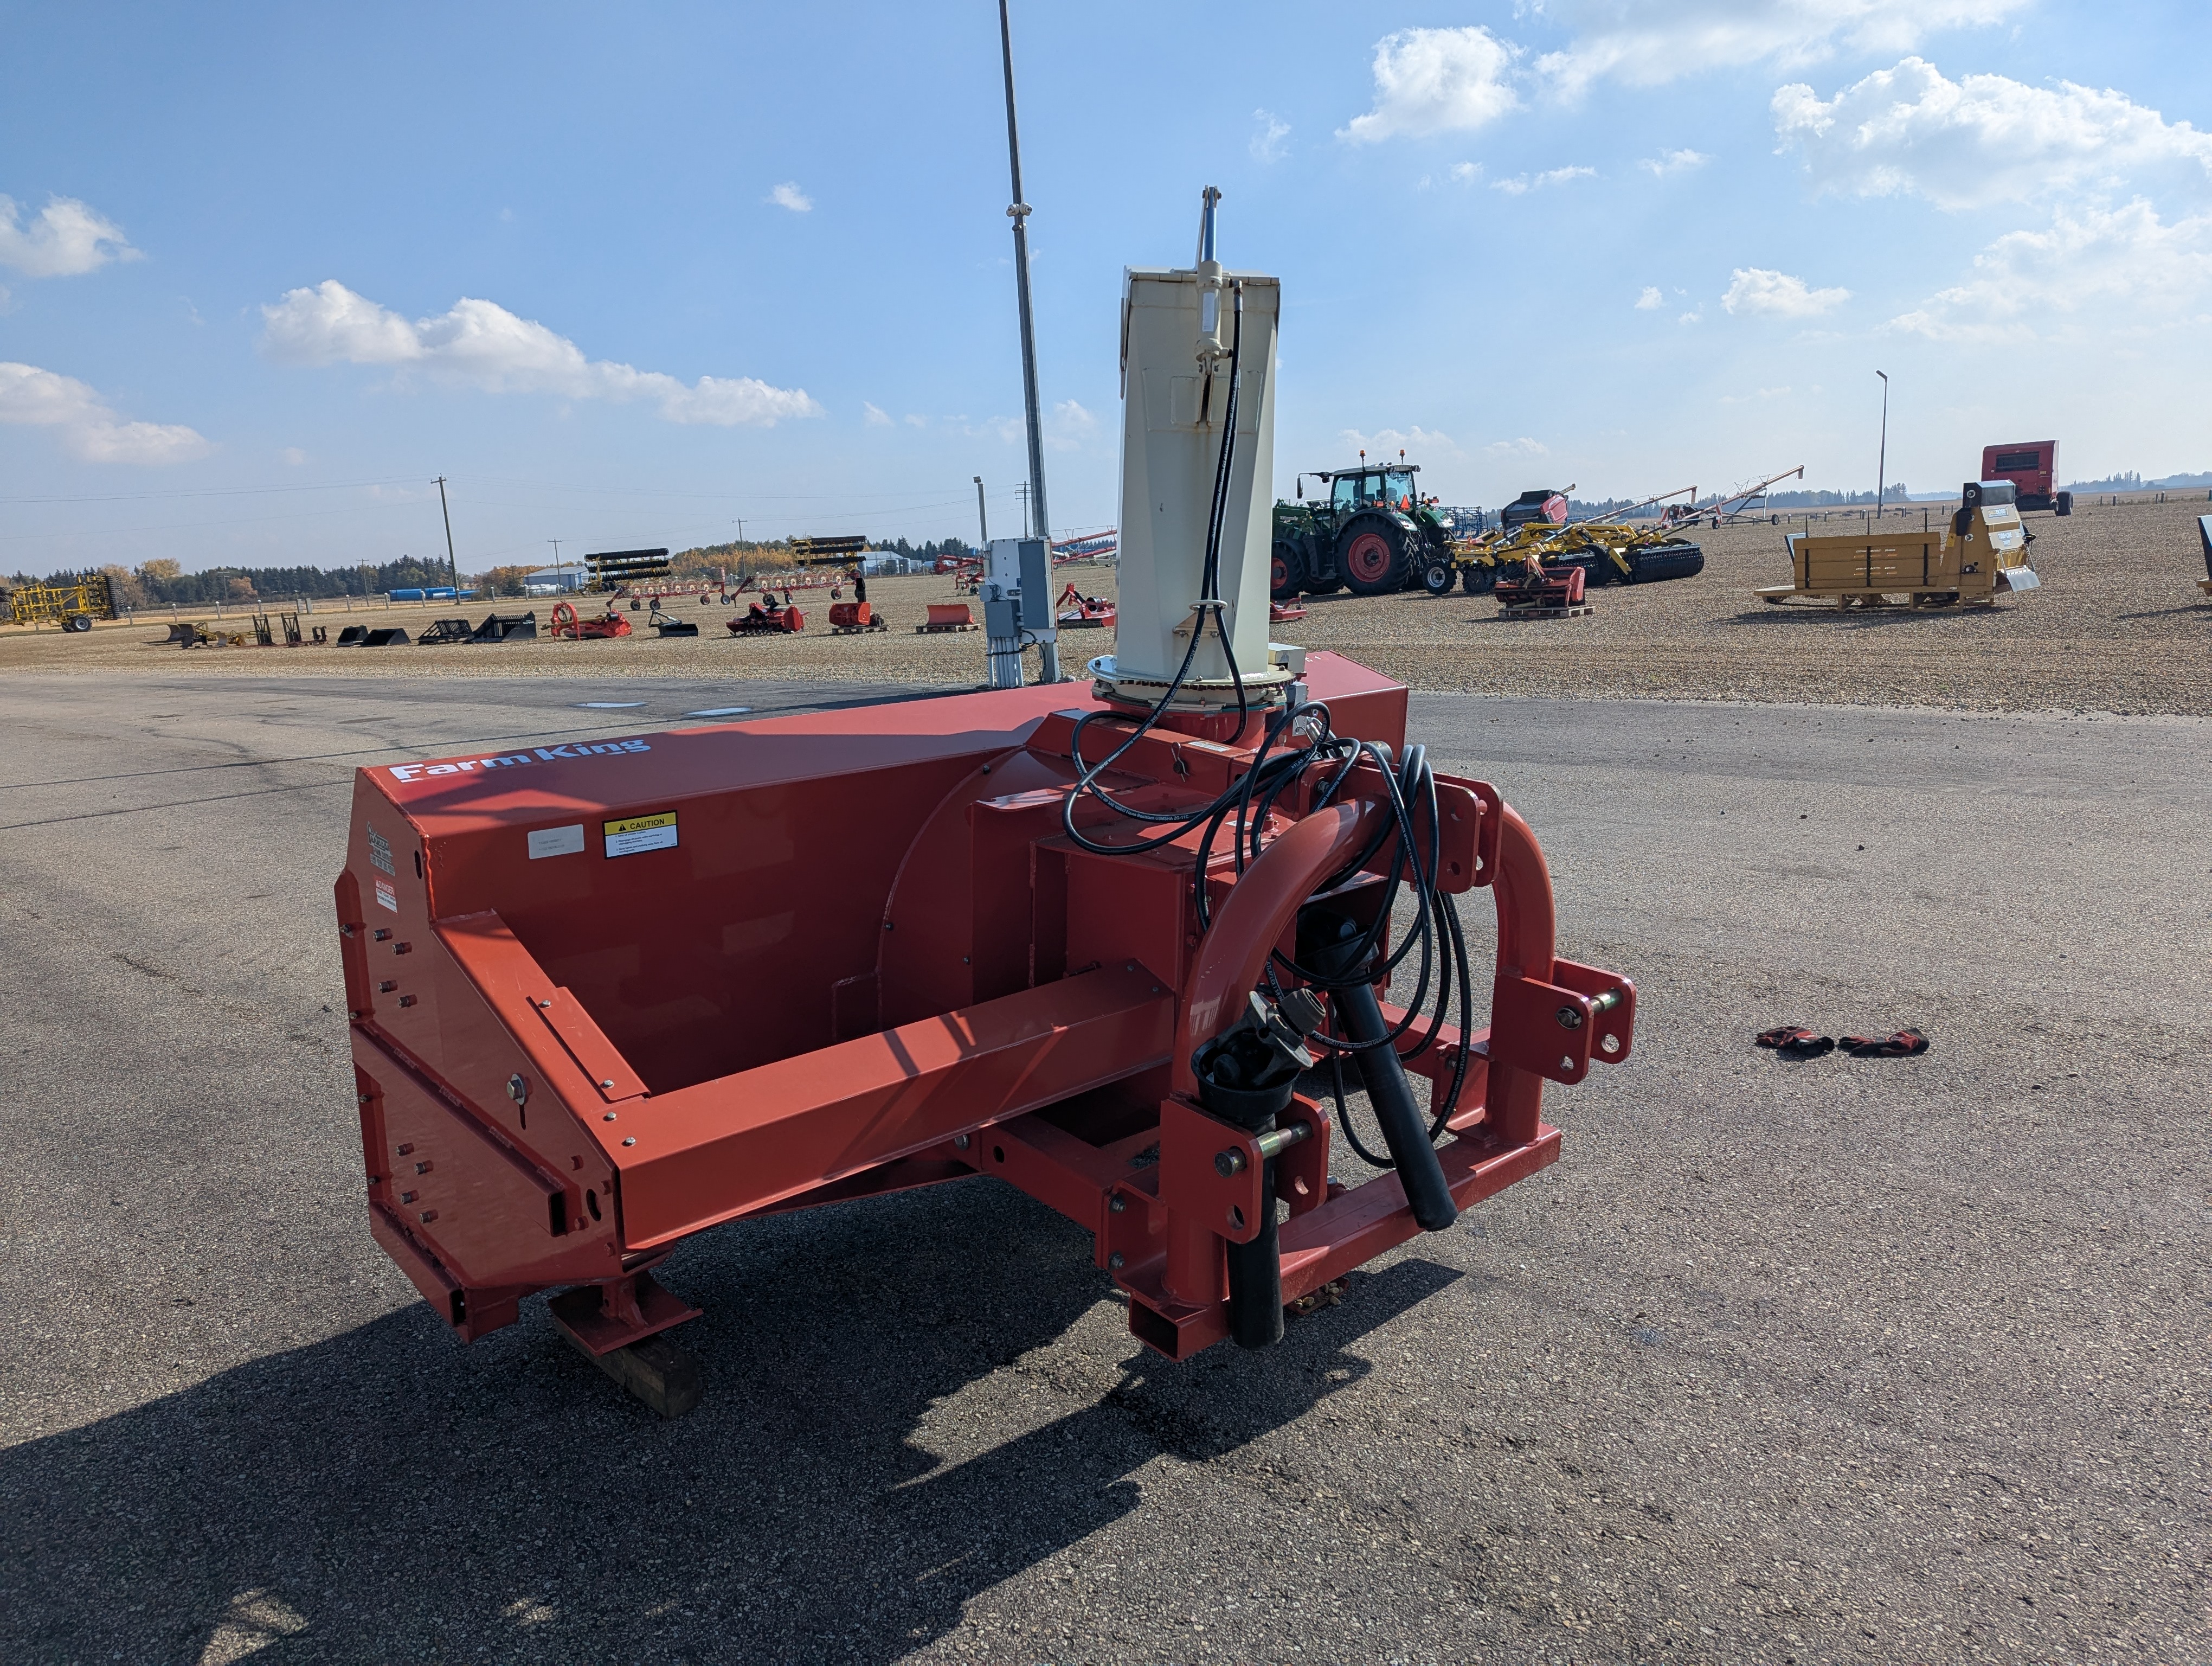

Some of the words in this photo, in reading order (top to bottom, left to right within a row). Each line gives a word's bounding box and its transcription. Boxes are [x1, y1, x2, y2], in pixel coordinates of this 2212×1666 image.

[389, 754, 532, 781] Farm
[533, 739, 651, 761] King
[1291, 758, 1304, 769] ATLAS
[1315, 797, 1328, 813] USMSH
[630, 818, 665, 830] CAUTION
[378, 880, 394, 895] DANGER
[1314, 1033, 1323, 1041] SAE
[1324, 1037, 1340, 1047] 100R17
